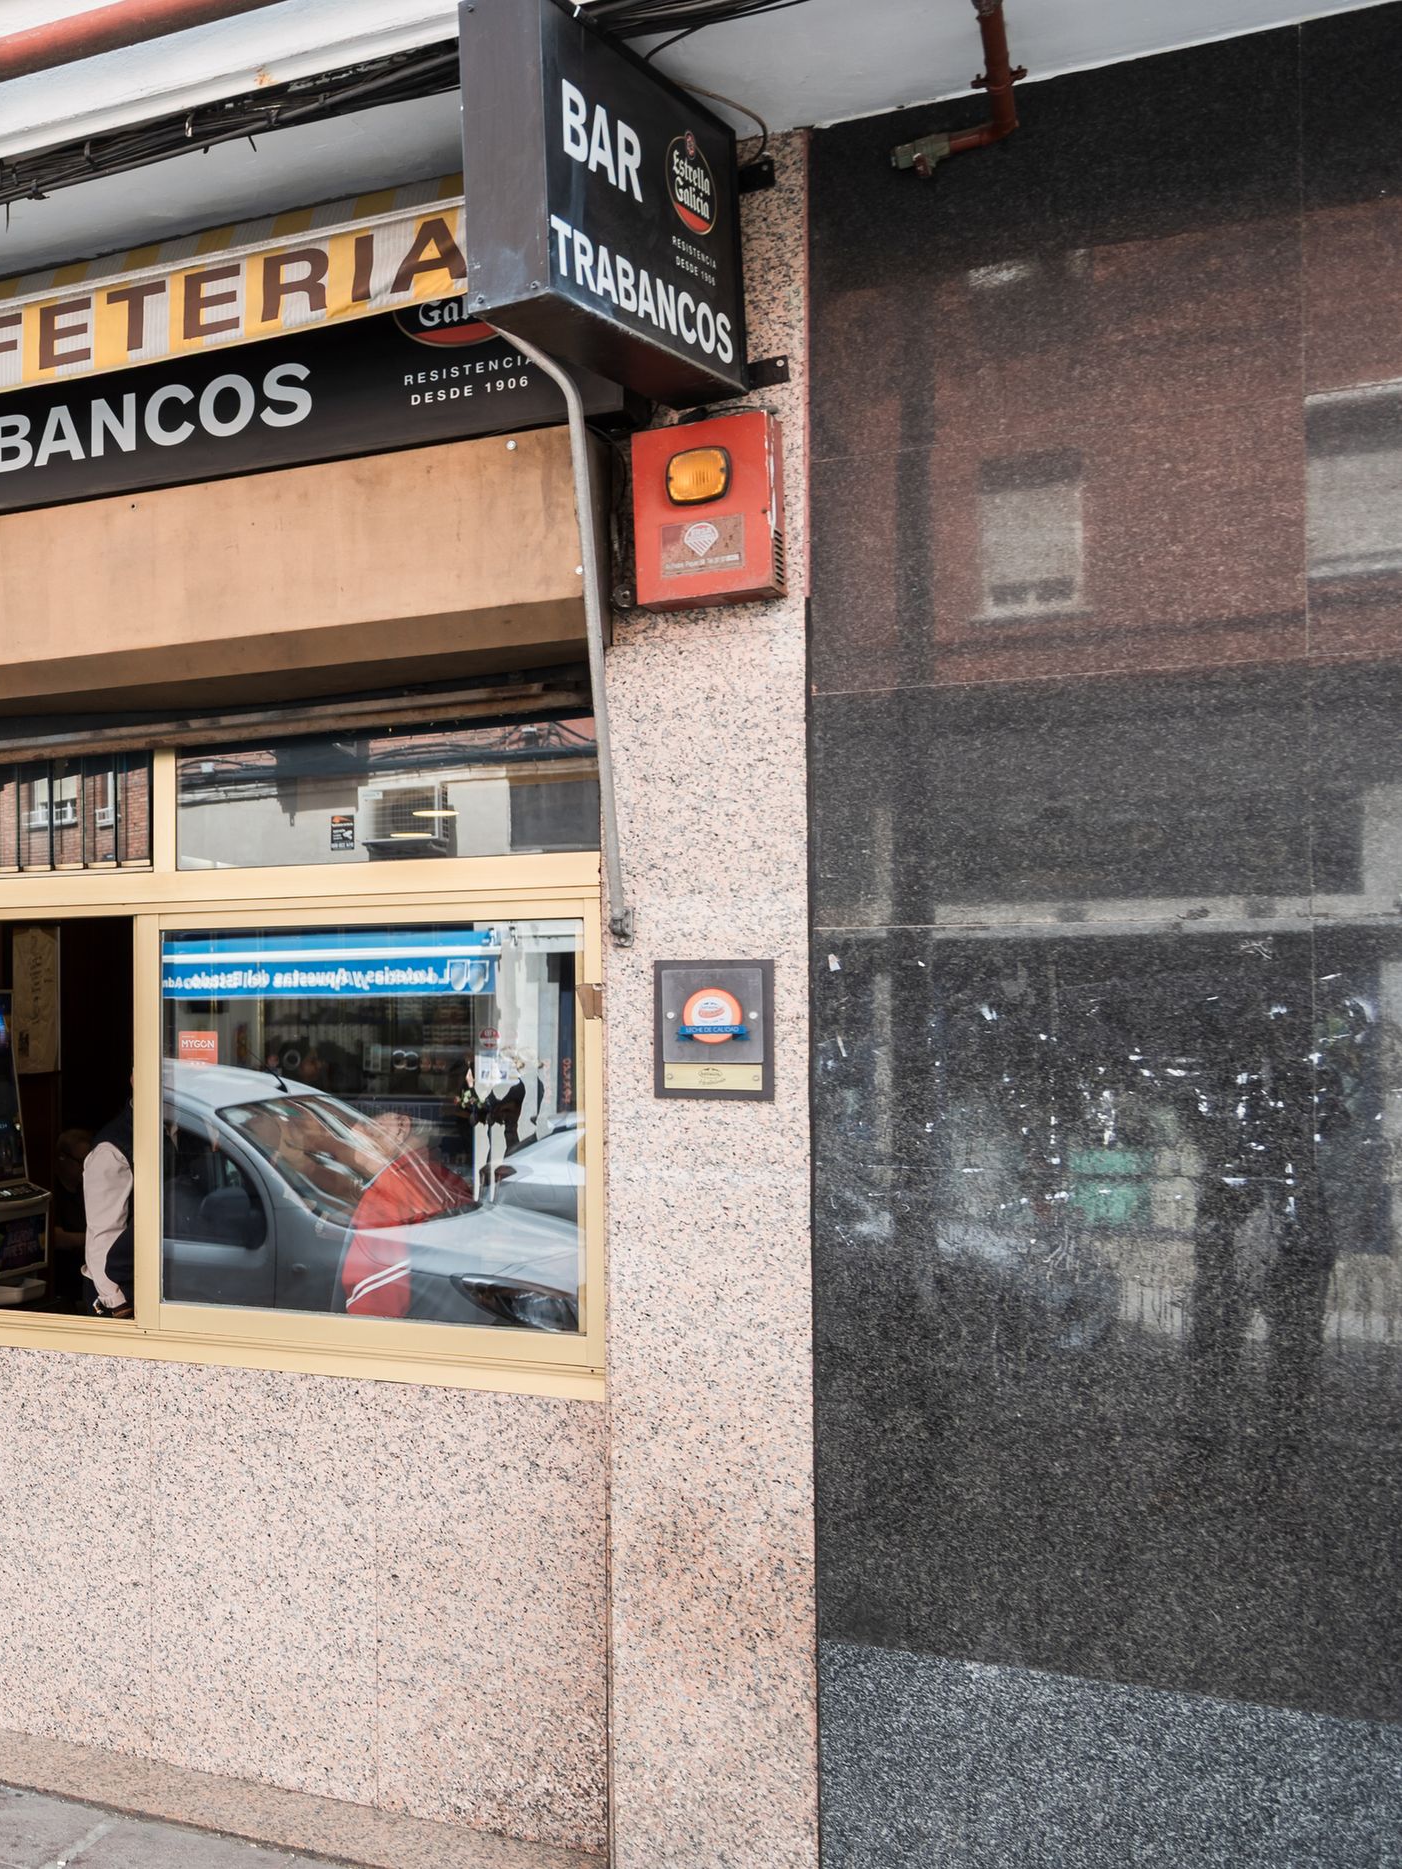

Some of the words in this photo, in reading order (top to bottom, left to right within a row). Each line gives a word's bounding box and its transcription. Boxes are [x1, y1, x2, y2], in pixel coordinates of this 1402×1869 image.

[560, 78, 643, 204] BAR
[672, 148, 711, 196] Estrella
[674, 177, 710, 220] Galicia
[672, 235, 717, 270] RESISTENCIA
[675, 255, 699, 277] DESDE
[700, 270, 716, 287] 1906
[550, 214, 734, 364] TRABANCOS
[410, 385, 474, 406] DESDE
[485, 375, 529, 393] 1906
